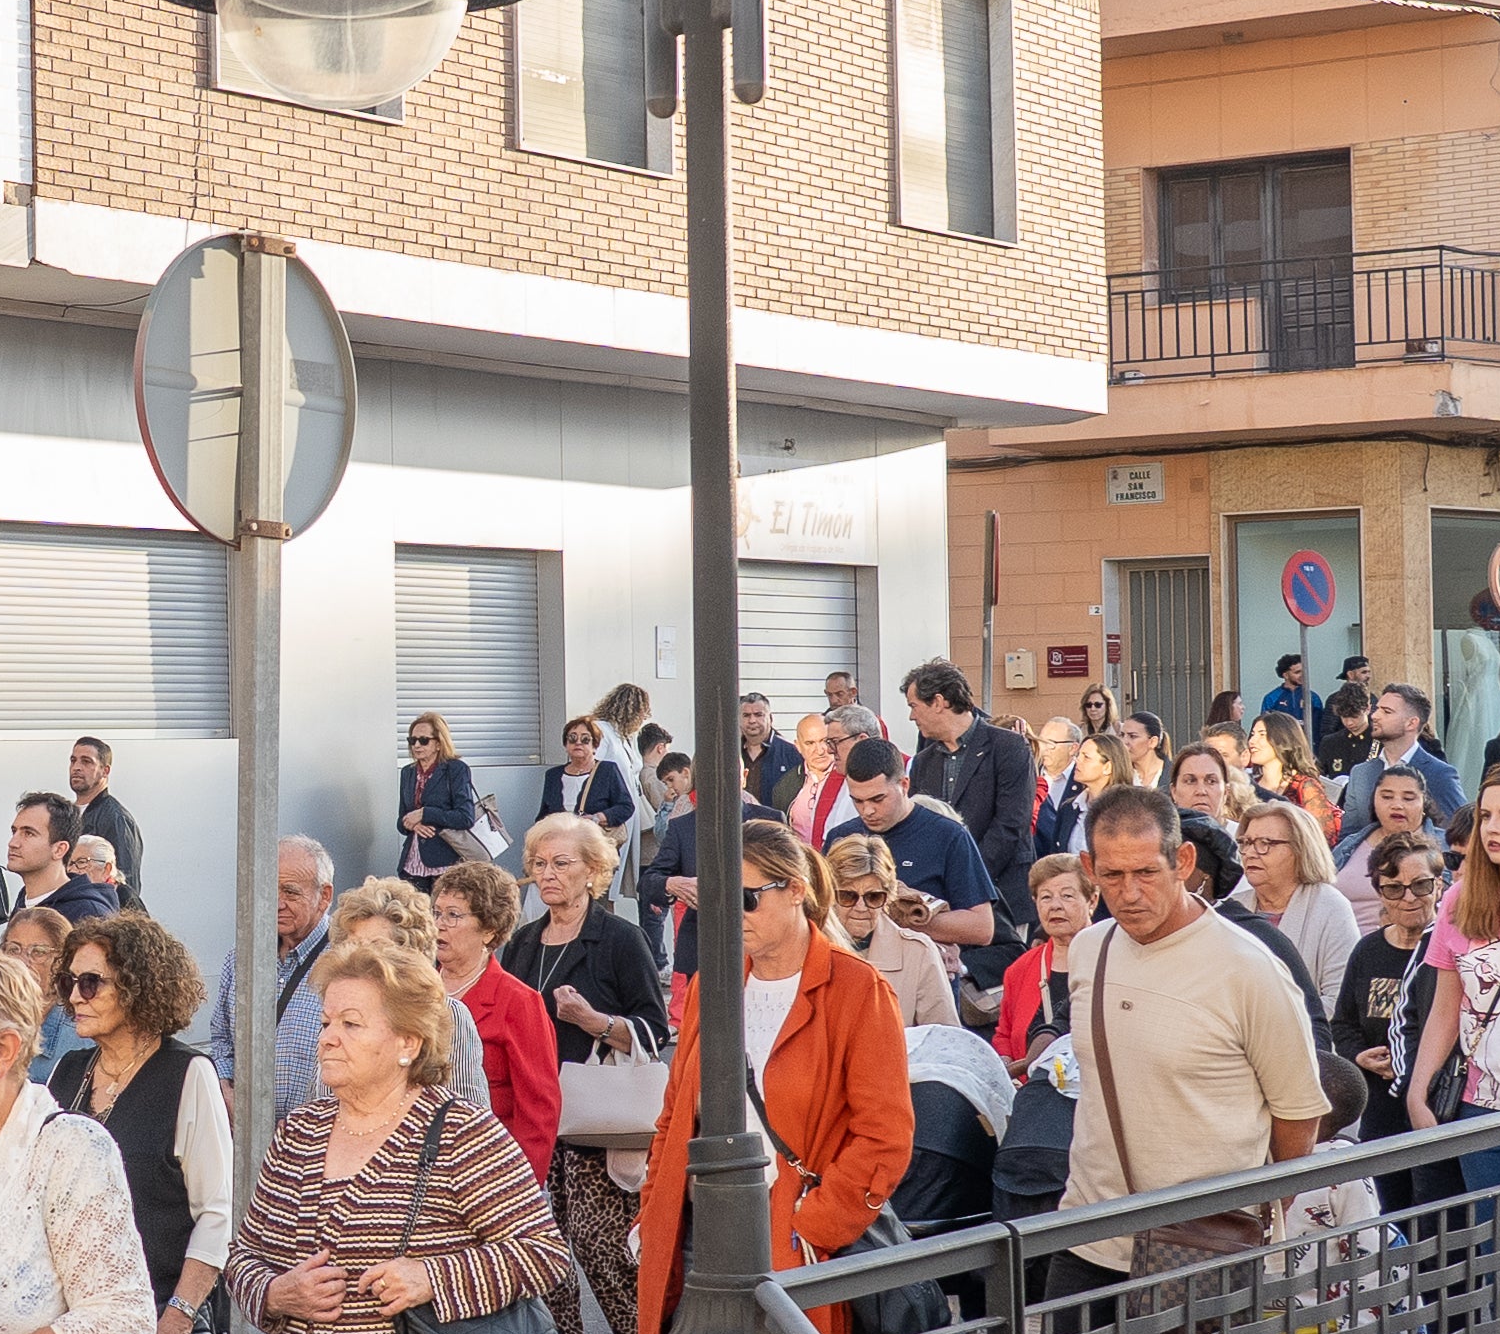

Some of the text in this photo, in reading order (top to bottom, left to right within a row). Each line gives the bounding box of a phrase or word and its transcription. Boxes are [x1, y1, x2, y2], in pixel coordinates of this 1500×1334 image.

[1129, 471, 1151, 480] CALLE
[1127, 482, 1144, 491] SAN
[1115, 491, 1157, 501] FRANCISCO
